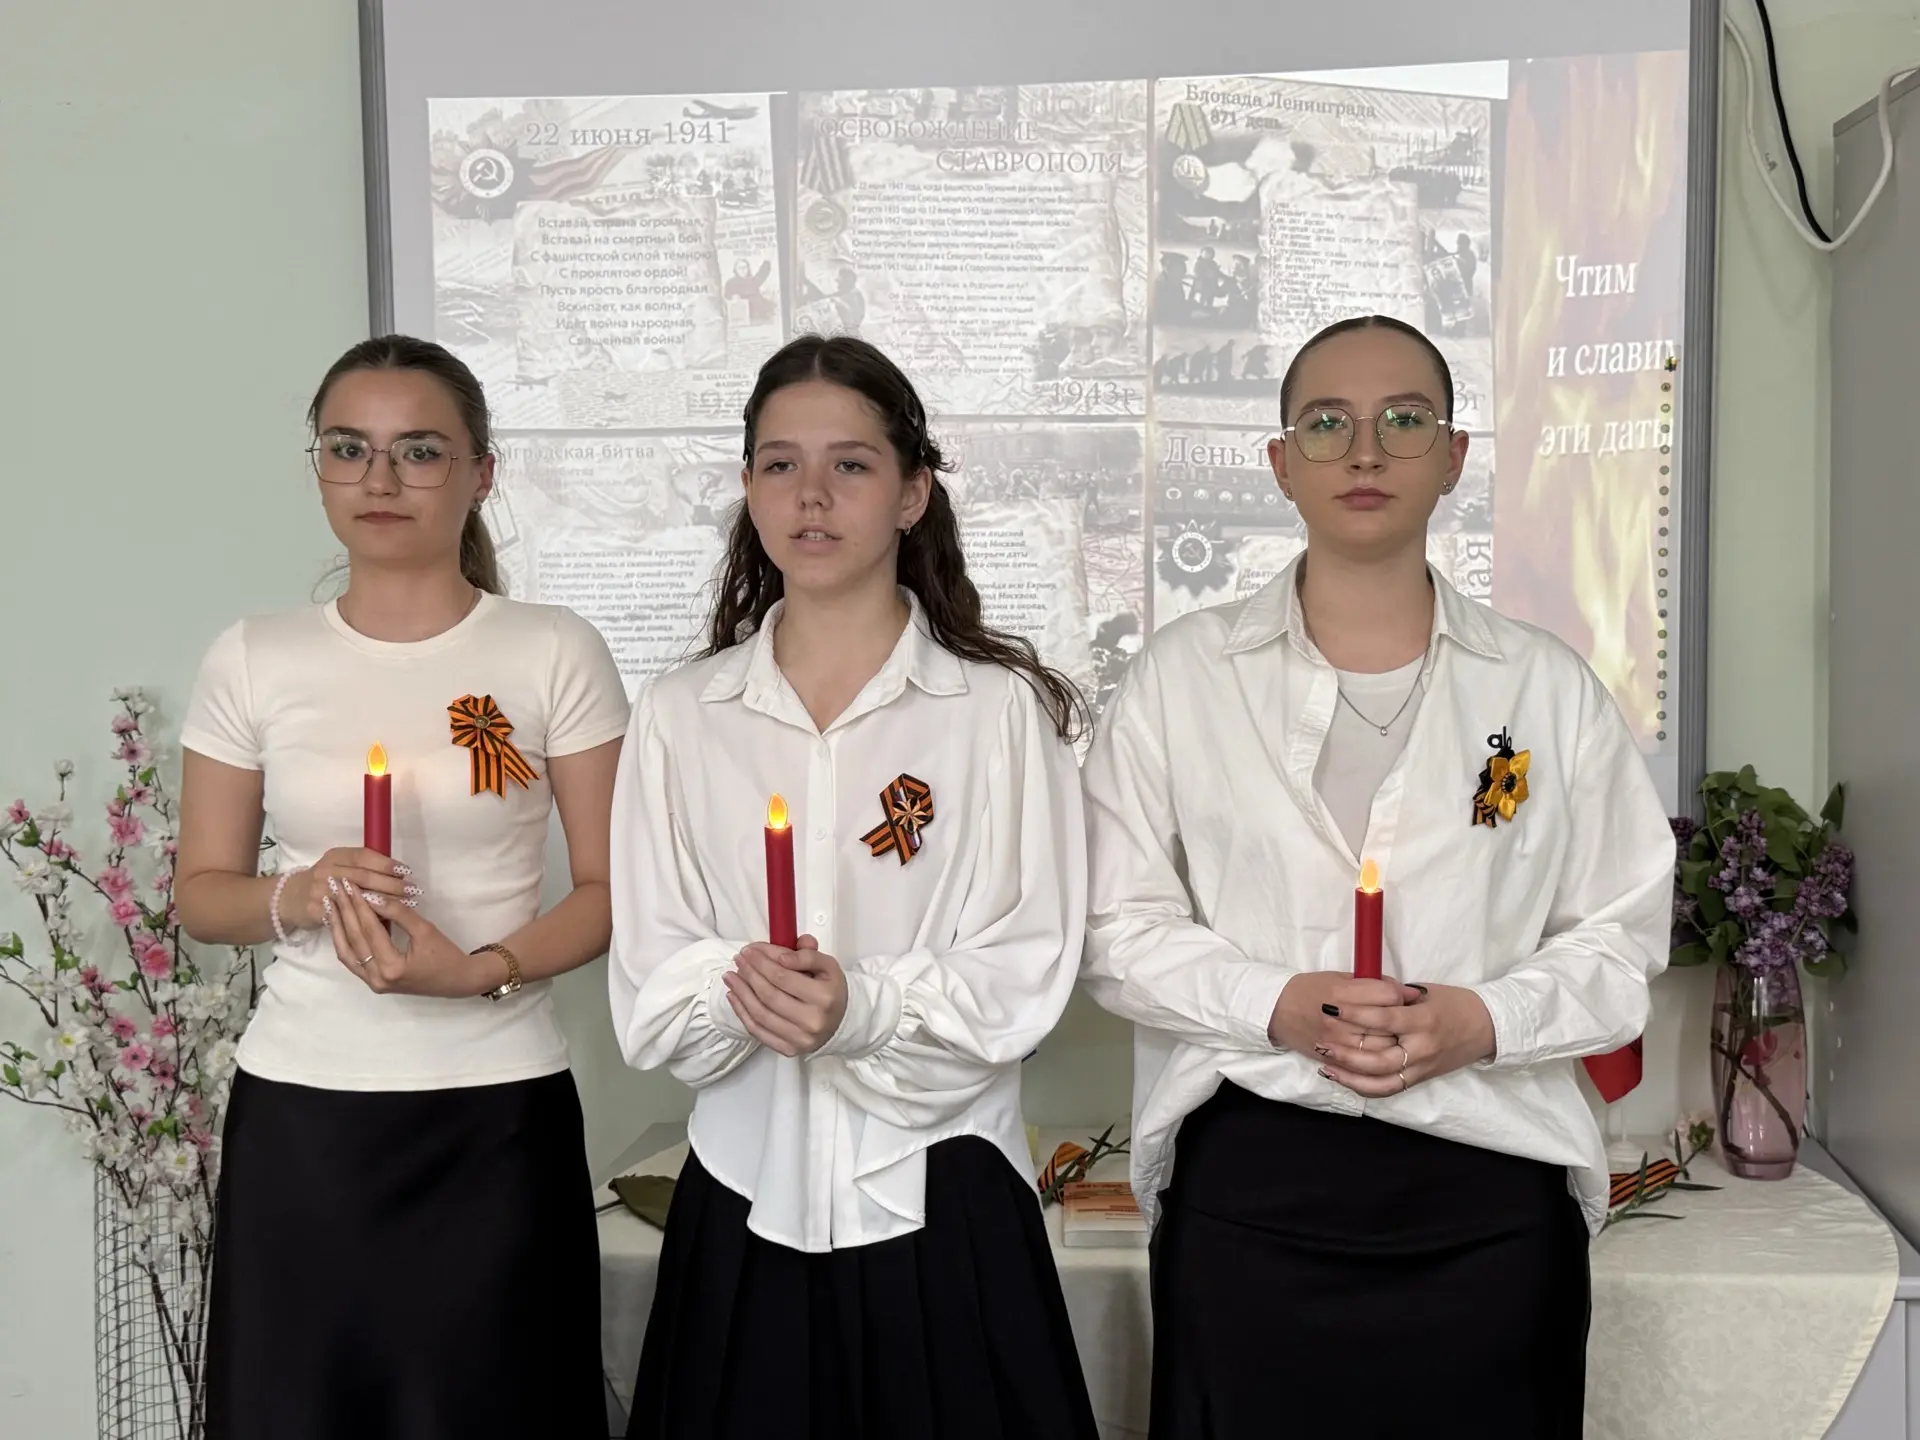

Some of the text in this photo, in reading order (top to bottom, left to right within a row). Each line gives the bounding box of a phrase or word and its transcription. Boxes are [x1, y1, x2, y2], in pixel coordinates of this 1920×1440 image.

[1184, 84, 1376, 118] Блокада Ленинграда
[1211, 110, 1237, 126] 871
[526, 120, 732, 146] 22 июня 1941
[820, 117, 1039, 142] ОСВОБОЖДЕНИЕ
[936, 151, 1124, 173] СТАВРОПОЛЯ
[542, 233, 591, 245] Вставай
[594, 236, 609, 245] на
[613, 234, 675, 246] смертный
[541, 251, 619, 264] фашистской
[622, 251, 660, 261] силой
[559, 267, 688, 280] С проклятою ордой!
[1556, 255, 1637, 298] Чтим
[541, 283, 708, 297] Пусть ярость благородная
[620, 304, 642, 312] как
[590, 318, 628, 329] война
[644, 334, 686, 345] война!
[1546, 346, 1568, 378] и
[1540, 418, 1674, 459] эти даты
[601, 443, 655, 459] битва
[1163, 436, 1246, 472] День
